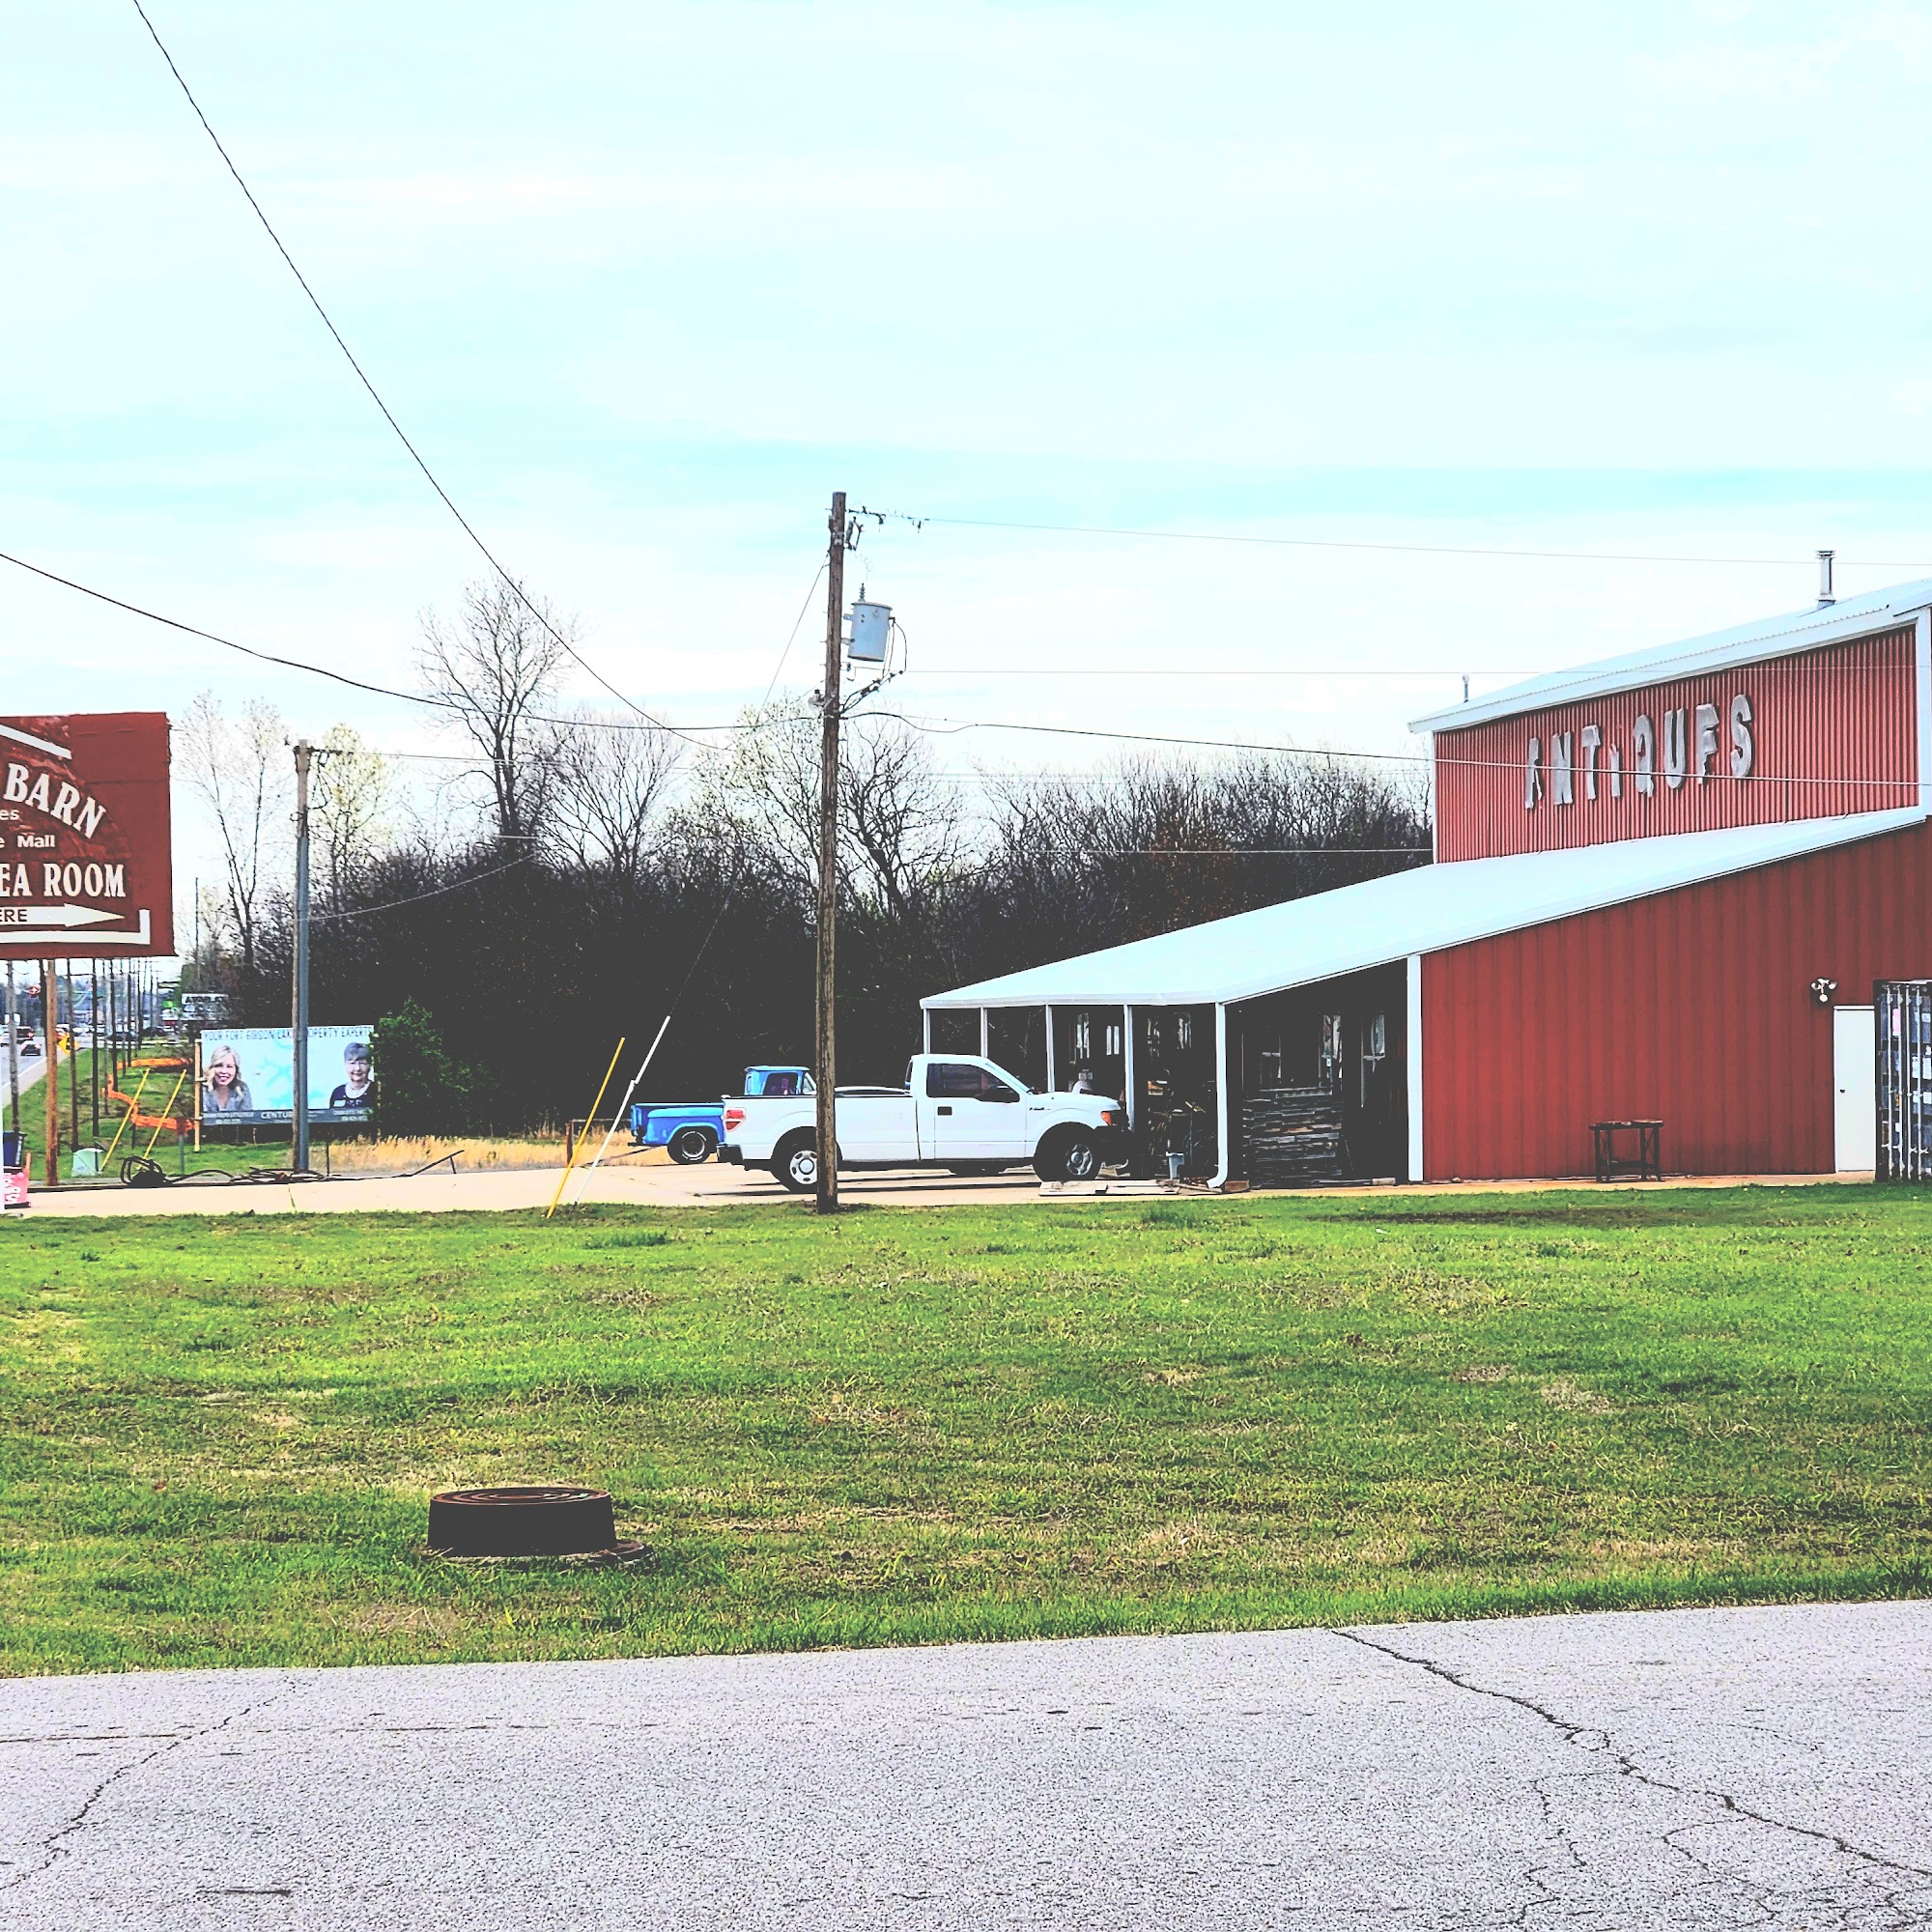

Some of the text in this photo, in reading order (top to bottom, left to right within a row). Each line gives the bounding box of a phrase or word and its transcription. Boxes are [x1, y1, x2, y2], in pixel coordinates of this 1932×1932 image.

[3, 762, 106, 839] BARN
[17, 834, 56, 848] Mall
[43, 863, 127, 897] ROOM
[0, 909, 28, 923] RE
[308, 1027, 339, 1038] OPERTY
